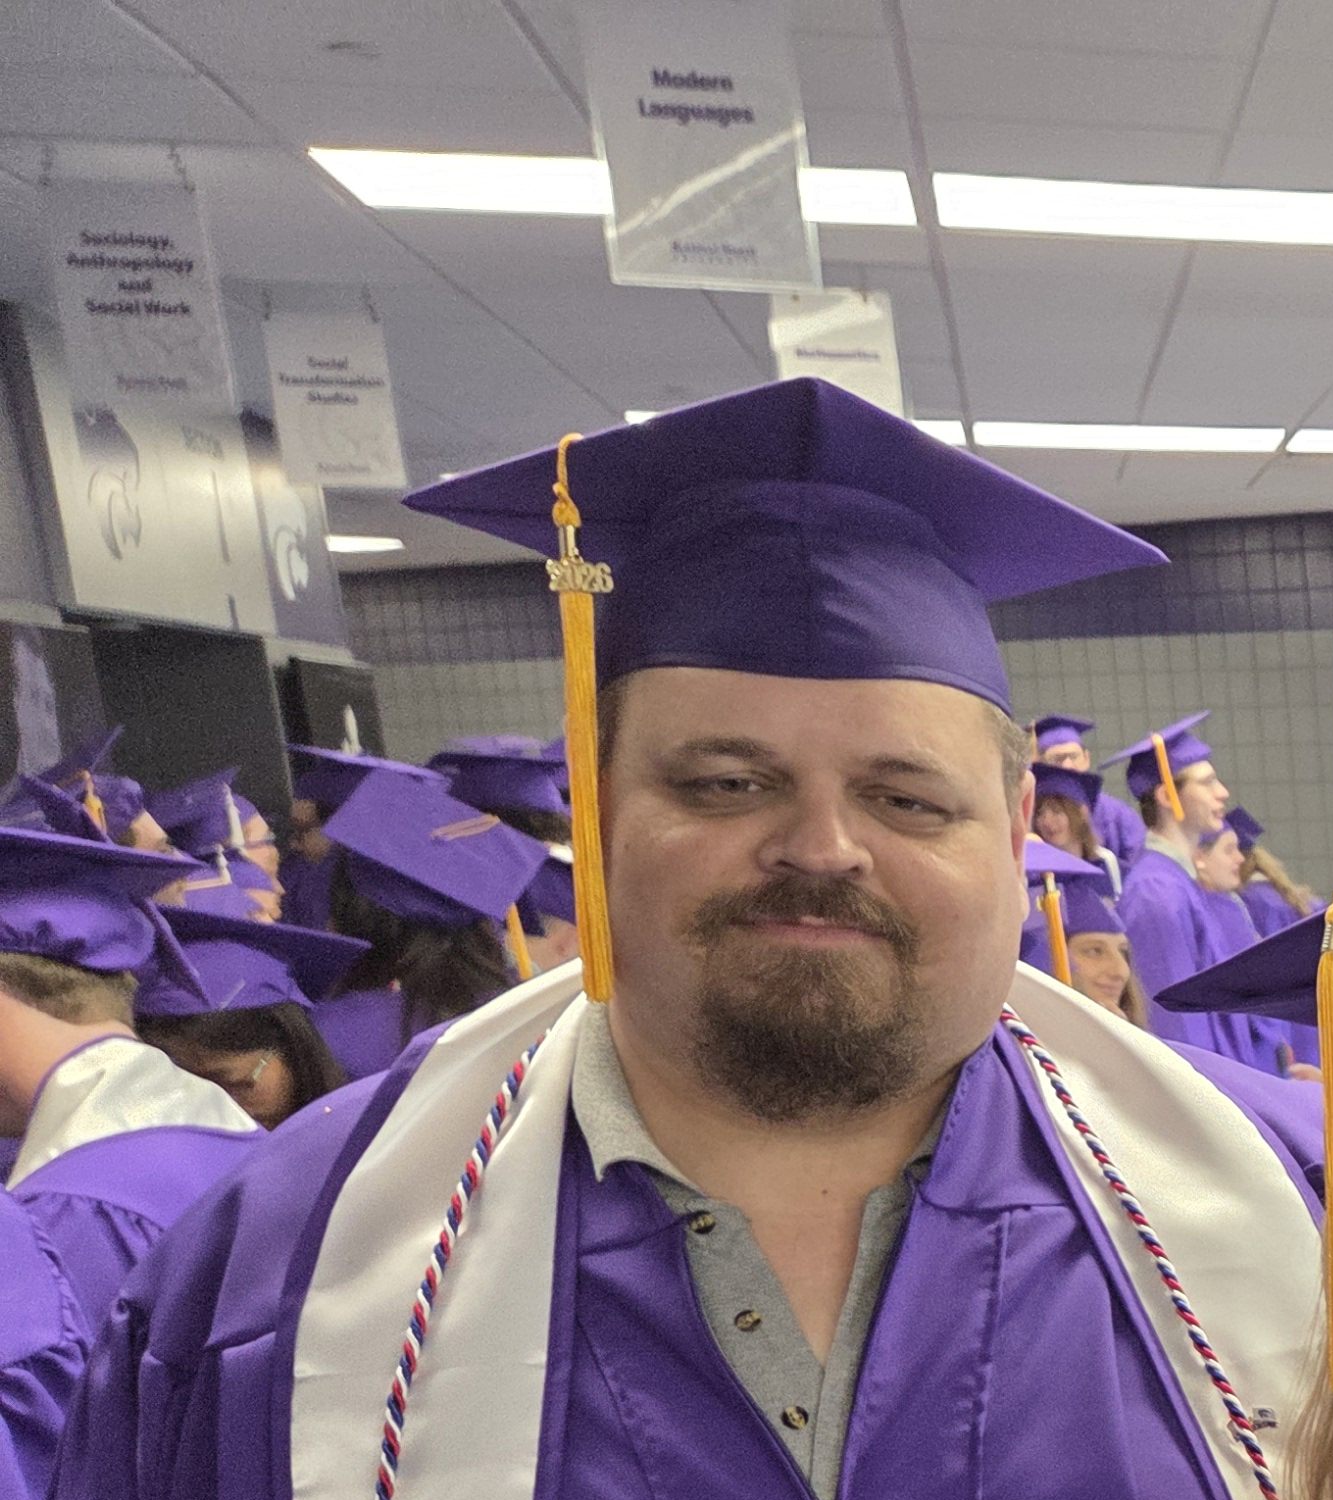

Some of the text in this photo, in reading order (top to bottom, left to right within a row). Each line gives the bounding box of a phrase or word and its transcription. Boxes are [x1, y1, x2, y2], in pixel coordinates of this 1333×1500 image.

[652, 67, 733, 90] Modern
[638, 98, 754, 127] Languages
[66, 252, 194, 274] Anthropology
[86, 299, 191, 316] Social Work
[546, 558, 614, 593] 2026
